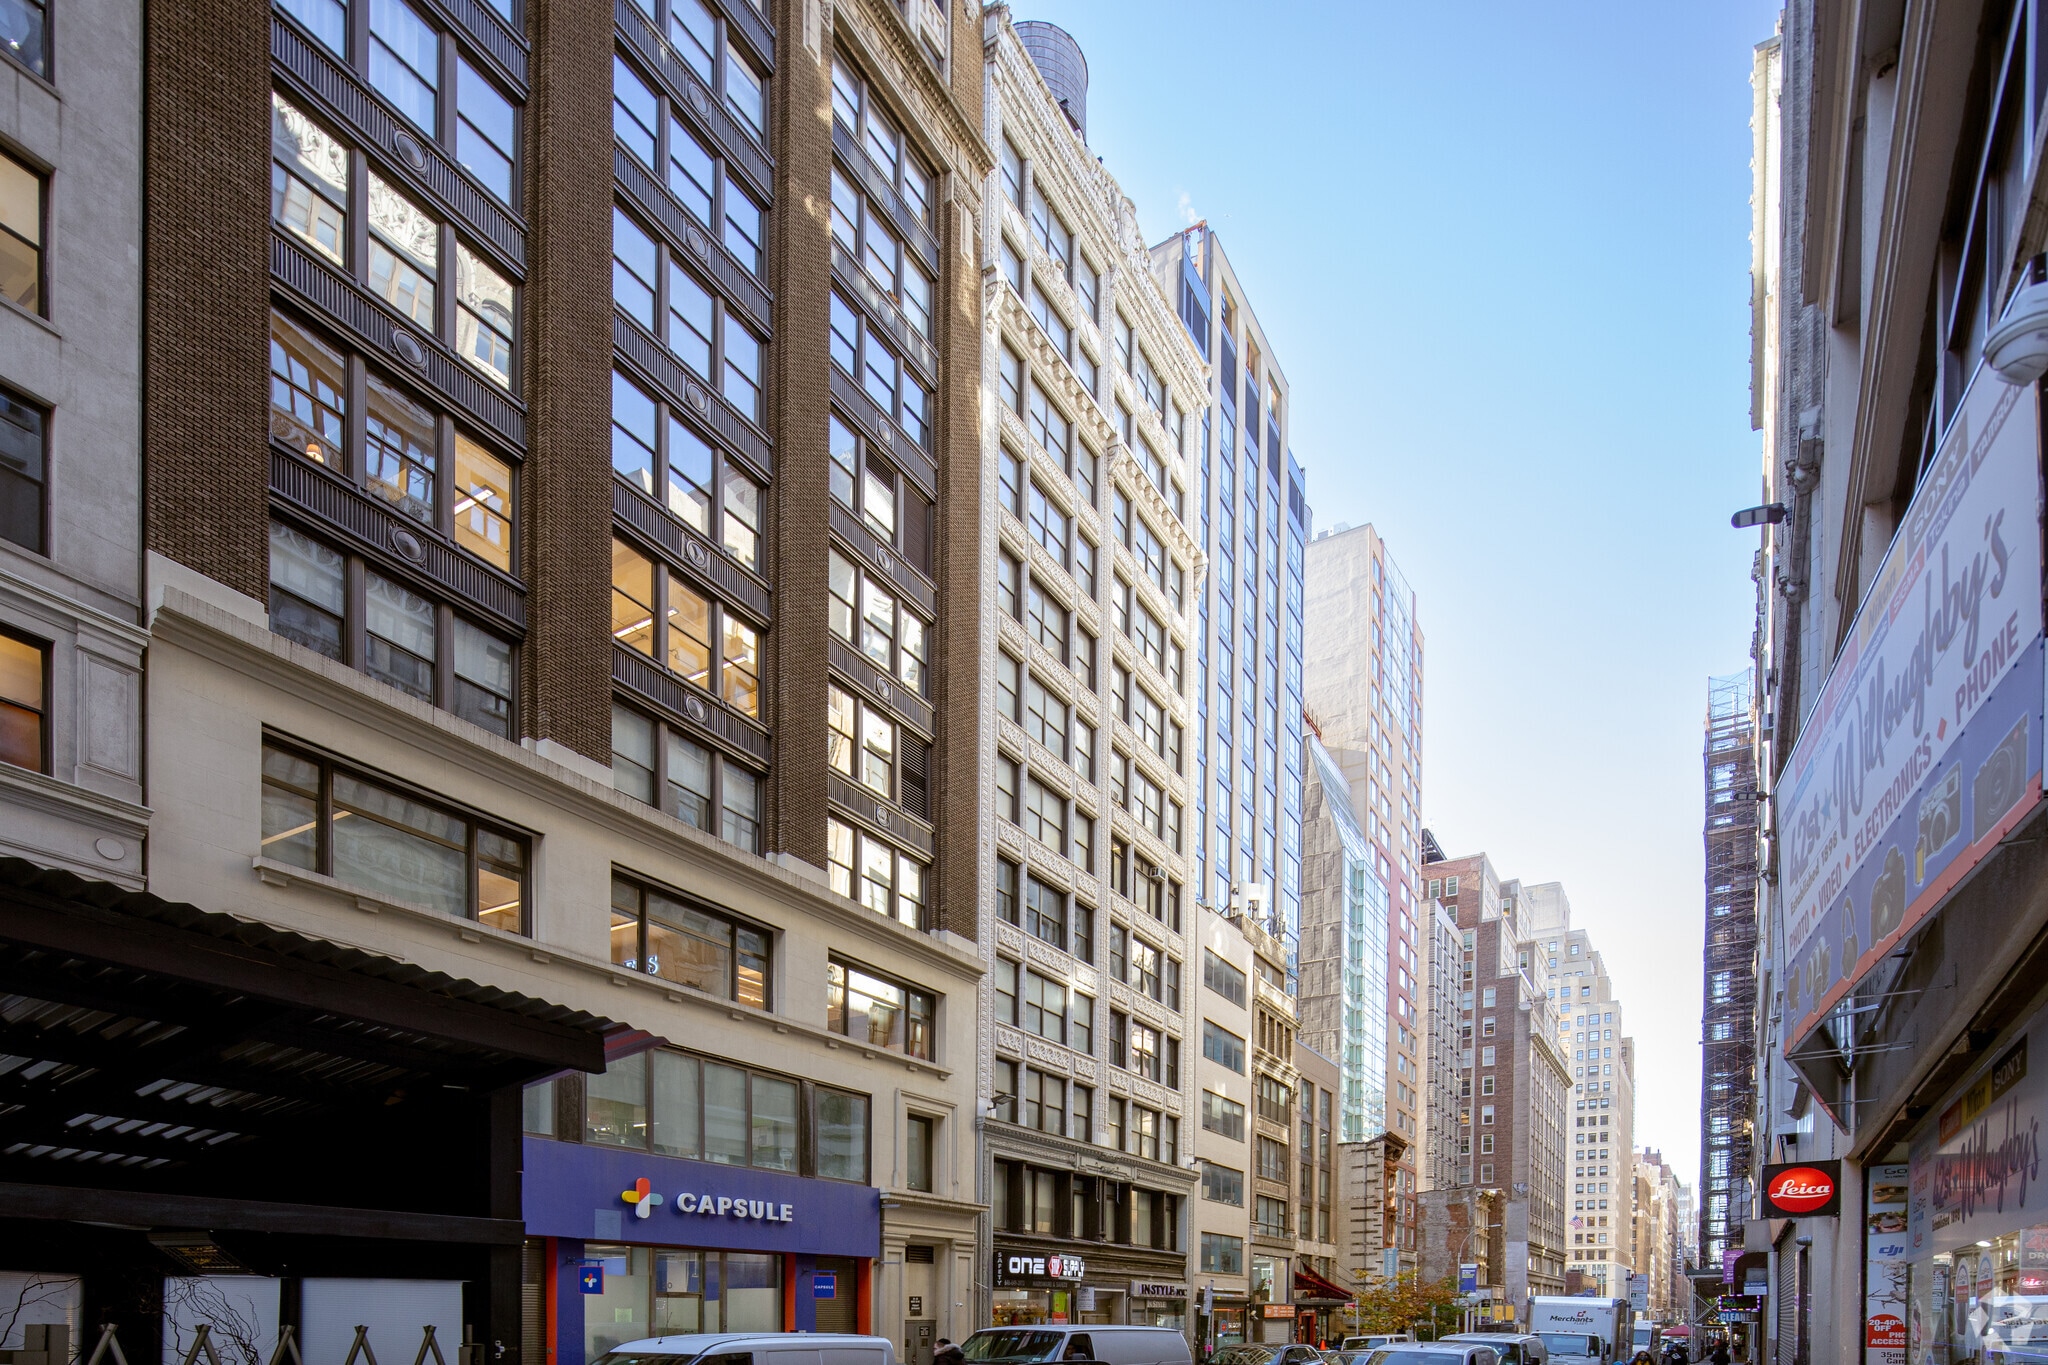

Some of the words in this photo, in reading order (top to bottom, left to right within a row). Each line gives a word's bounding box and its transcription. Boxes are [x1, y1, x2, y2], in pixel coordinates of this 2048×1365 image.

[1867, 566, 1897, 629] Nikon
[1913, 437, 1963, 541] SONY
[1860, 619, 1888, 676] Panasonic
[1893, 563, 1921, 610] SIGMA
[1833, 507, 2008, 840] Willoughby's
[1789, 909, 1810, 957] PHOTO
[1818, 861, 1842, 913] VIDEO
[1855, 733, 1932, 864] ELECTRONICS
[1955, 610, 2020, 726] PHONE
[1790, 858, 1820, 918] Established
[1821, 830, 1838, 867] 1898
[1994, 1049, 2023, 1091] SONY
[676, 1192, 793, 1222] CAPSULE
[1771, 1179, 1831, 1199] Leica
[1549, 1315, 1594, 1323] Merchants
